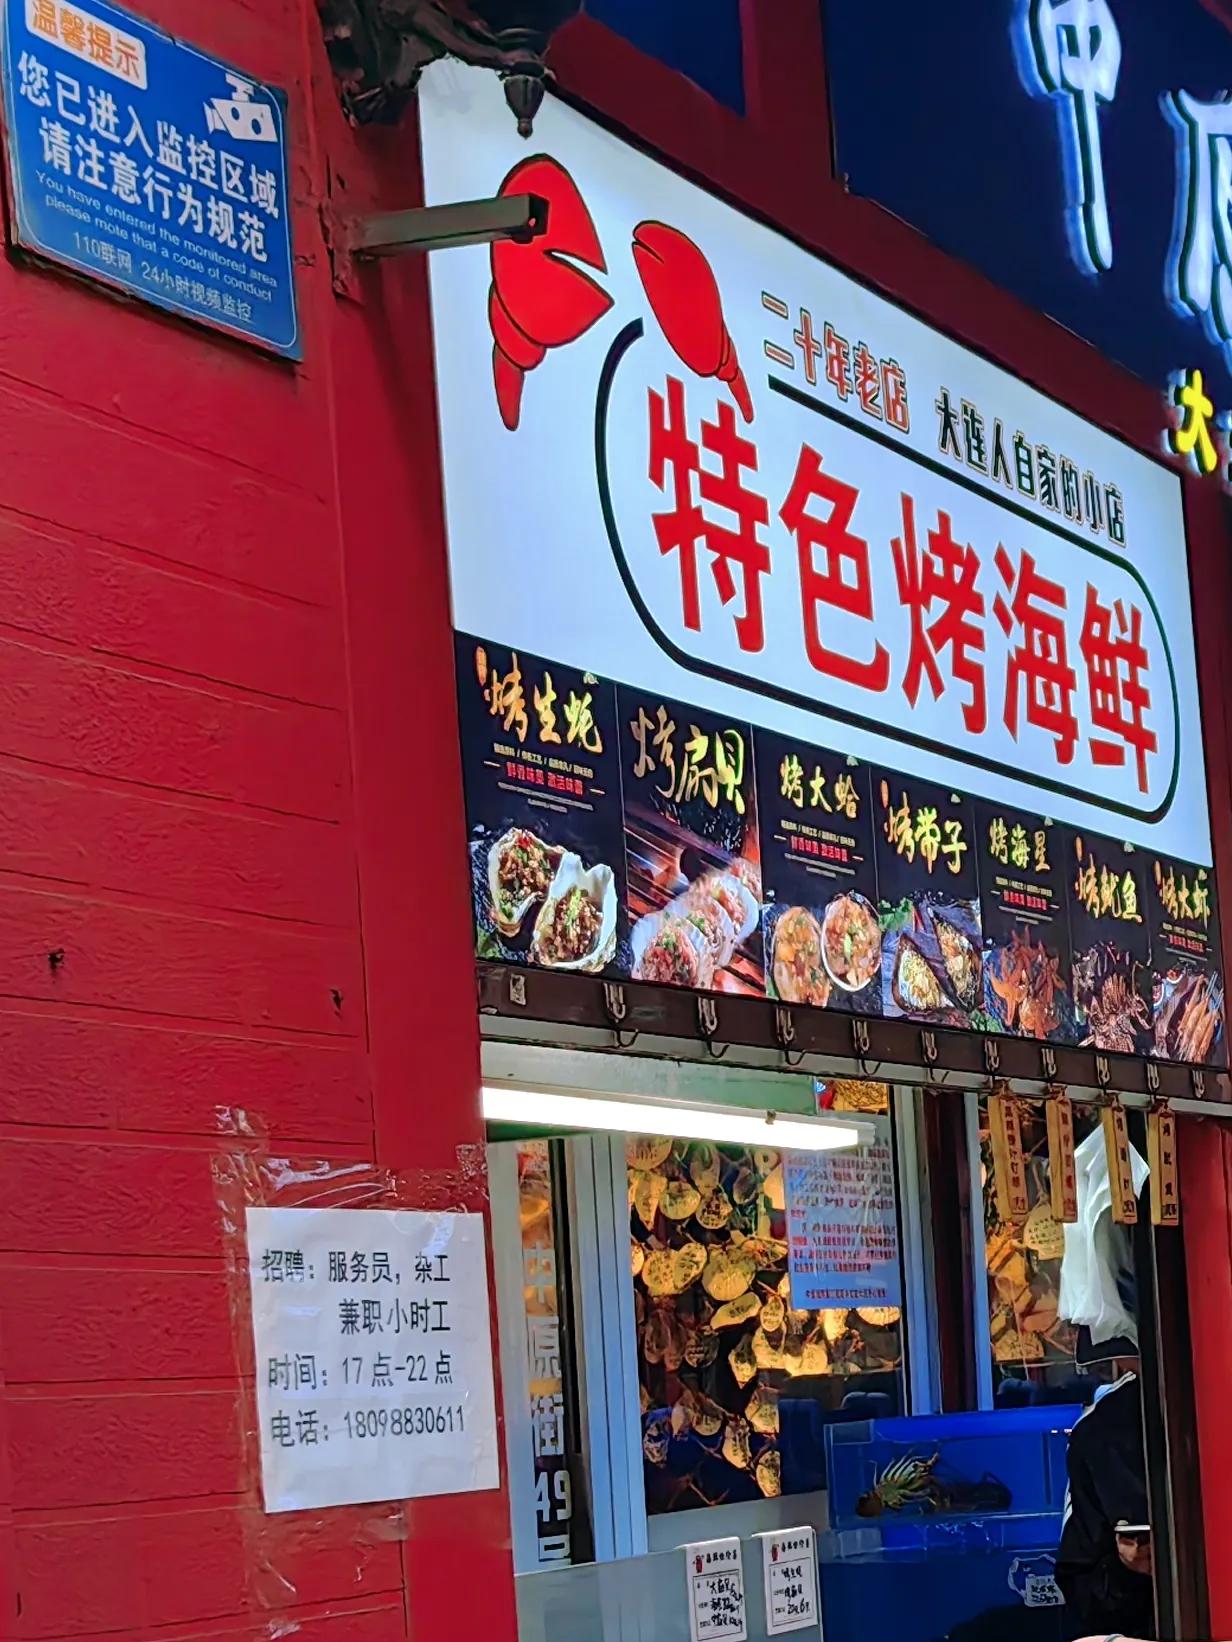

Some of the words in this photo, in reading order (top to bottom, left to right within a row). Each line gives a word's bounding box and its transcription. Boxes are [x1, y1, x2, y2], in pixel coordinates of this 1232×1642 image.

[32, 0, 141, 80] 温馨提示
[18, 51, 279, 219] 您已进入监控区域
[36, 170, 63, 195] You
[105, 200, 156, 235] entered
[159, 225, 180, 246] the
[184, 239, 247, 275] monitored
[250, 268, 278, 288] area
[40, 117, 269, 263] 请注意行为规范
[45, 194, 91, 224] please
[131, 231, 157, 253] that
[161, 246, 170, 259] a
[172, 251, 205, 274] code
[223, 274, 273, 303] conduct
[72, 231, 132, 274] 110联网
[141, 260, 253, 323] 24小时视频监控
[760, 290, 911, 434] 二十年老店
[935, 387, 1128, 548] 大连人自家的小店
[646, 374, 1160, 797] 特色烤海鲜
[482, 650, 603, 755] 烤生蚝
[629, 703, 747, 816] 烤扇贝
[884, 791, 968, 875] 烤带子
[988, 816, 1051, 873] 烤海星
[1074, 852, 1143, 924] 烤鱿鱼
[338, 1299, 451, 1336] 兼职小时工
